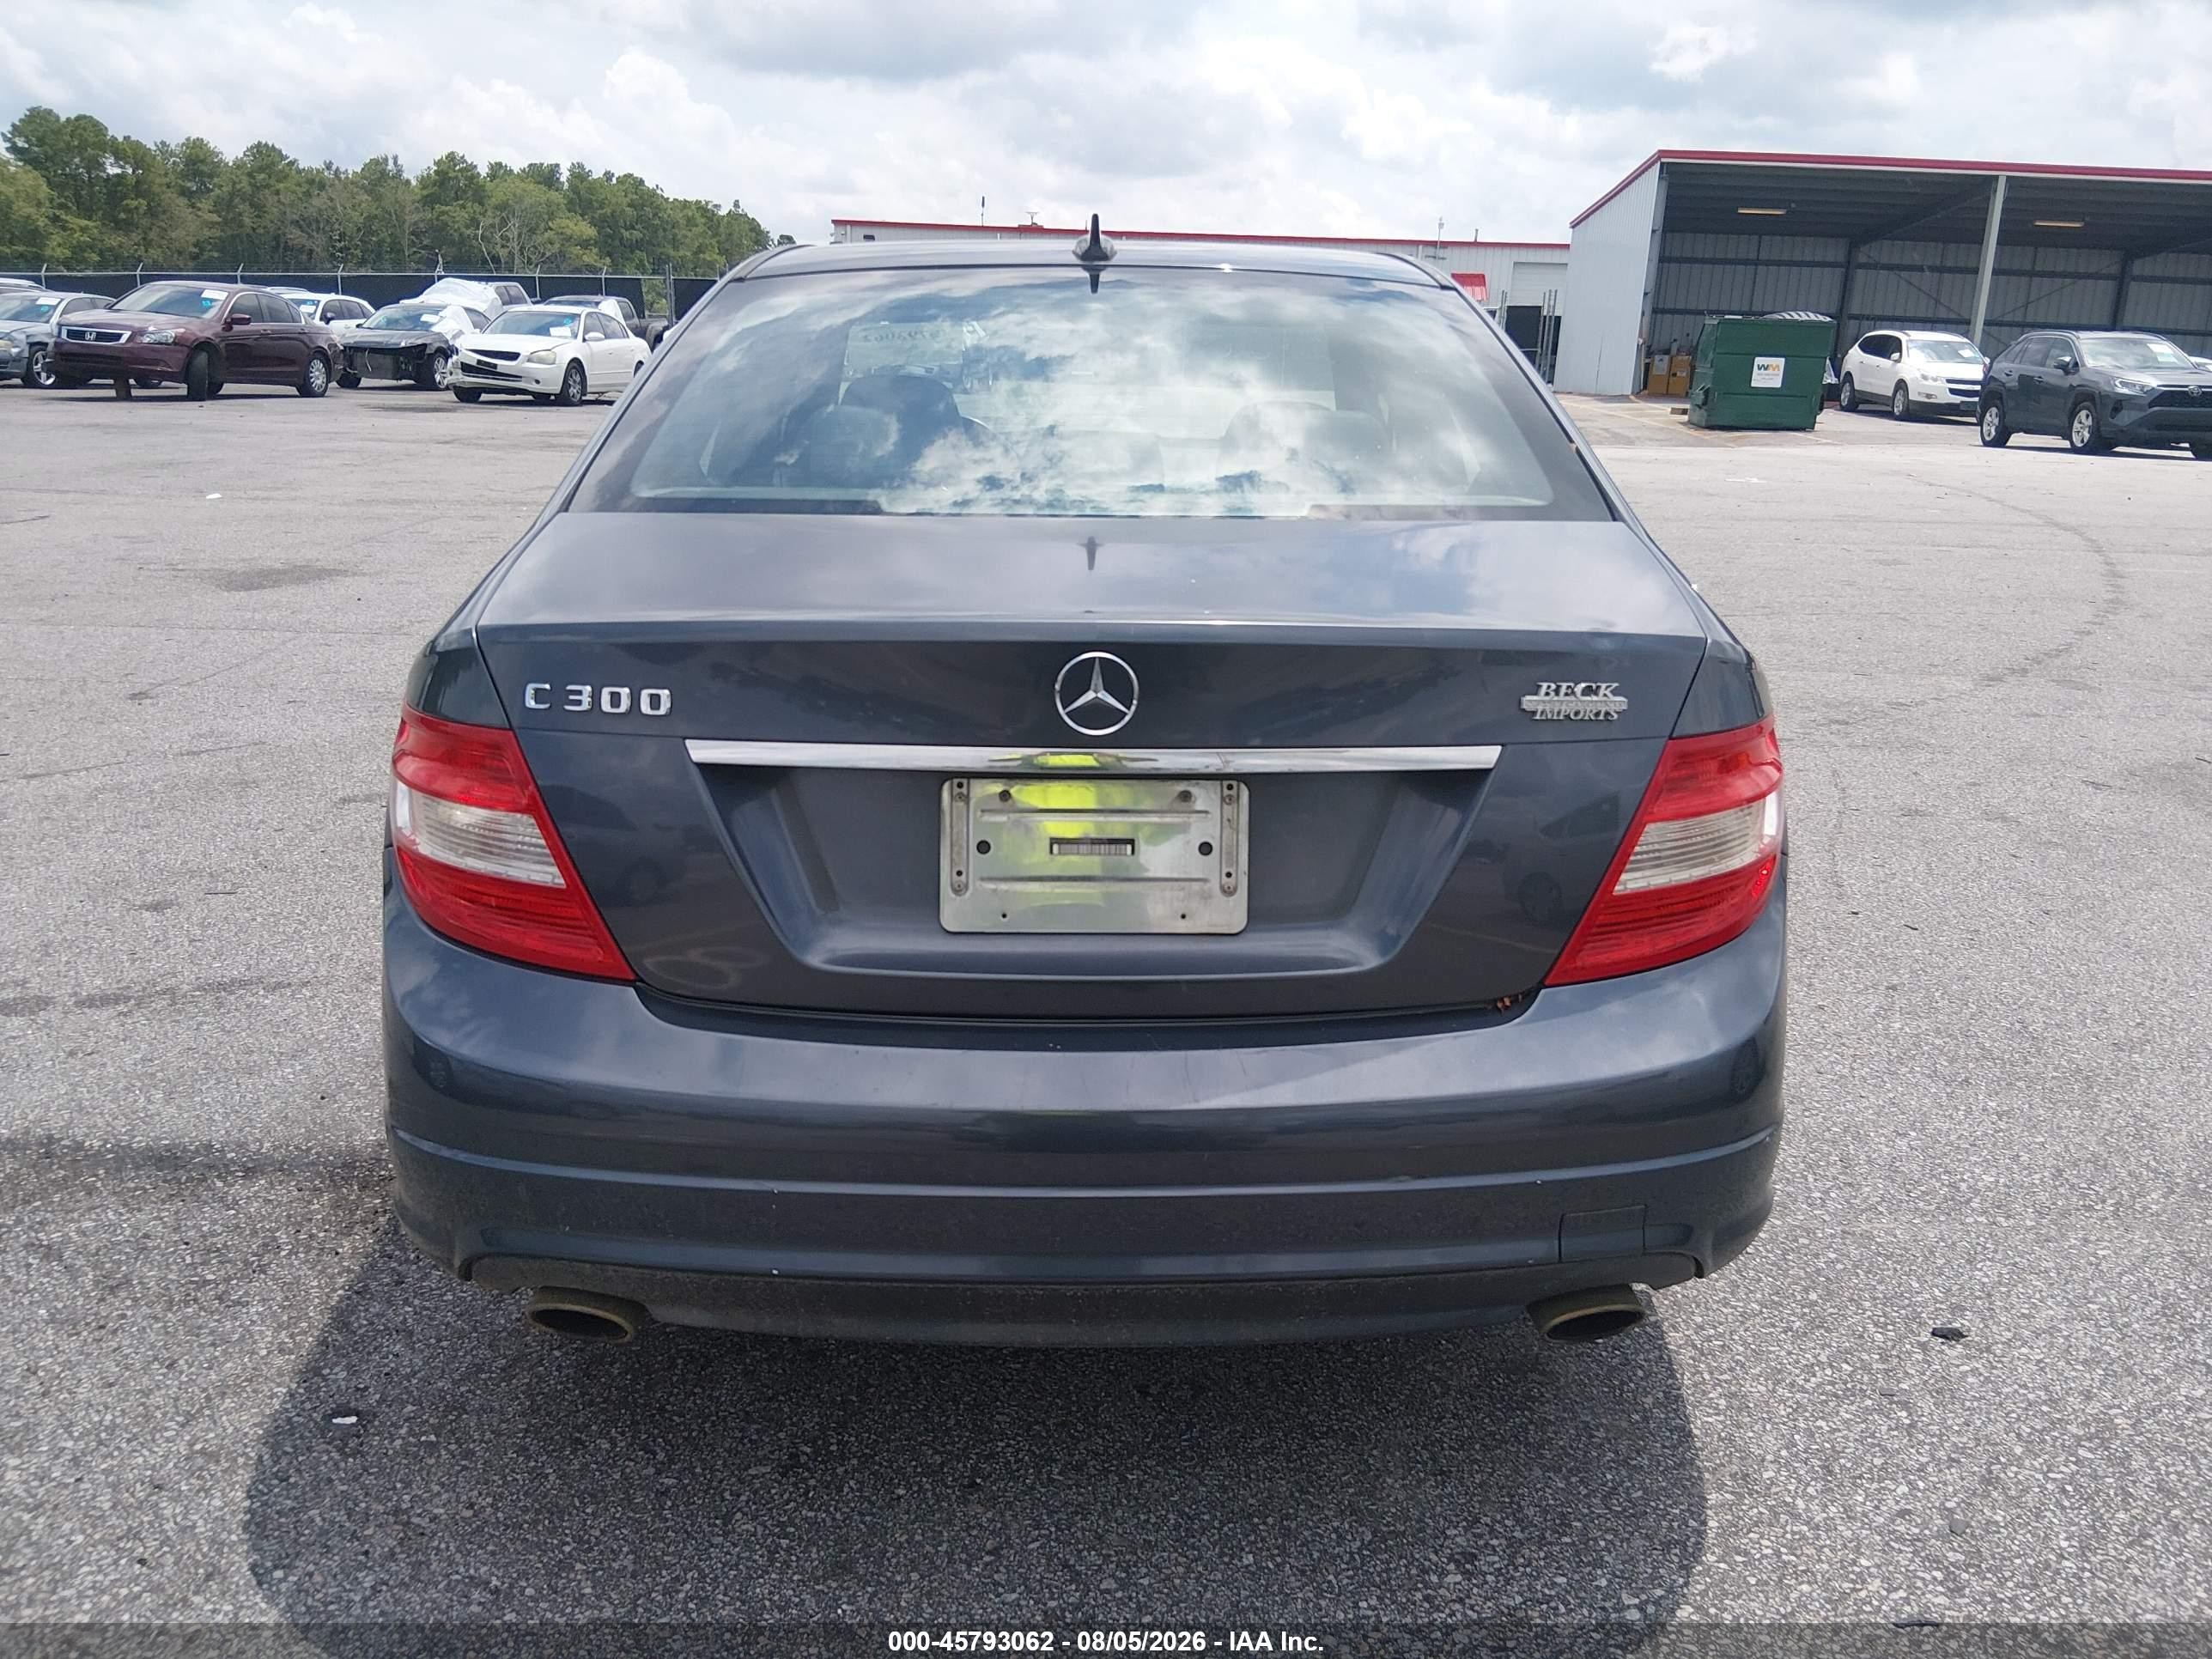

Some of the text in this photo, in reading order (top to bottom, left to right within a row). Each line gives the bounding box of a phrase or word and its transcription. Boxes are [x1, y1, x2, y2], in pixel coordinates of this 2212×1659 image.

[525, 683, 672, 716] C 300
[1536, 682, 1620, 701] BECK
[1533, 708, 1619, 720] IMPORTS
